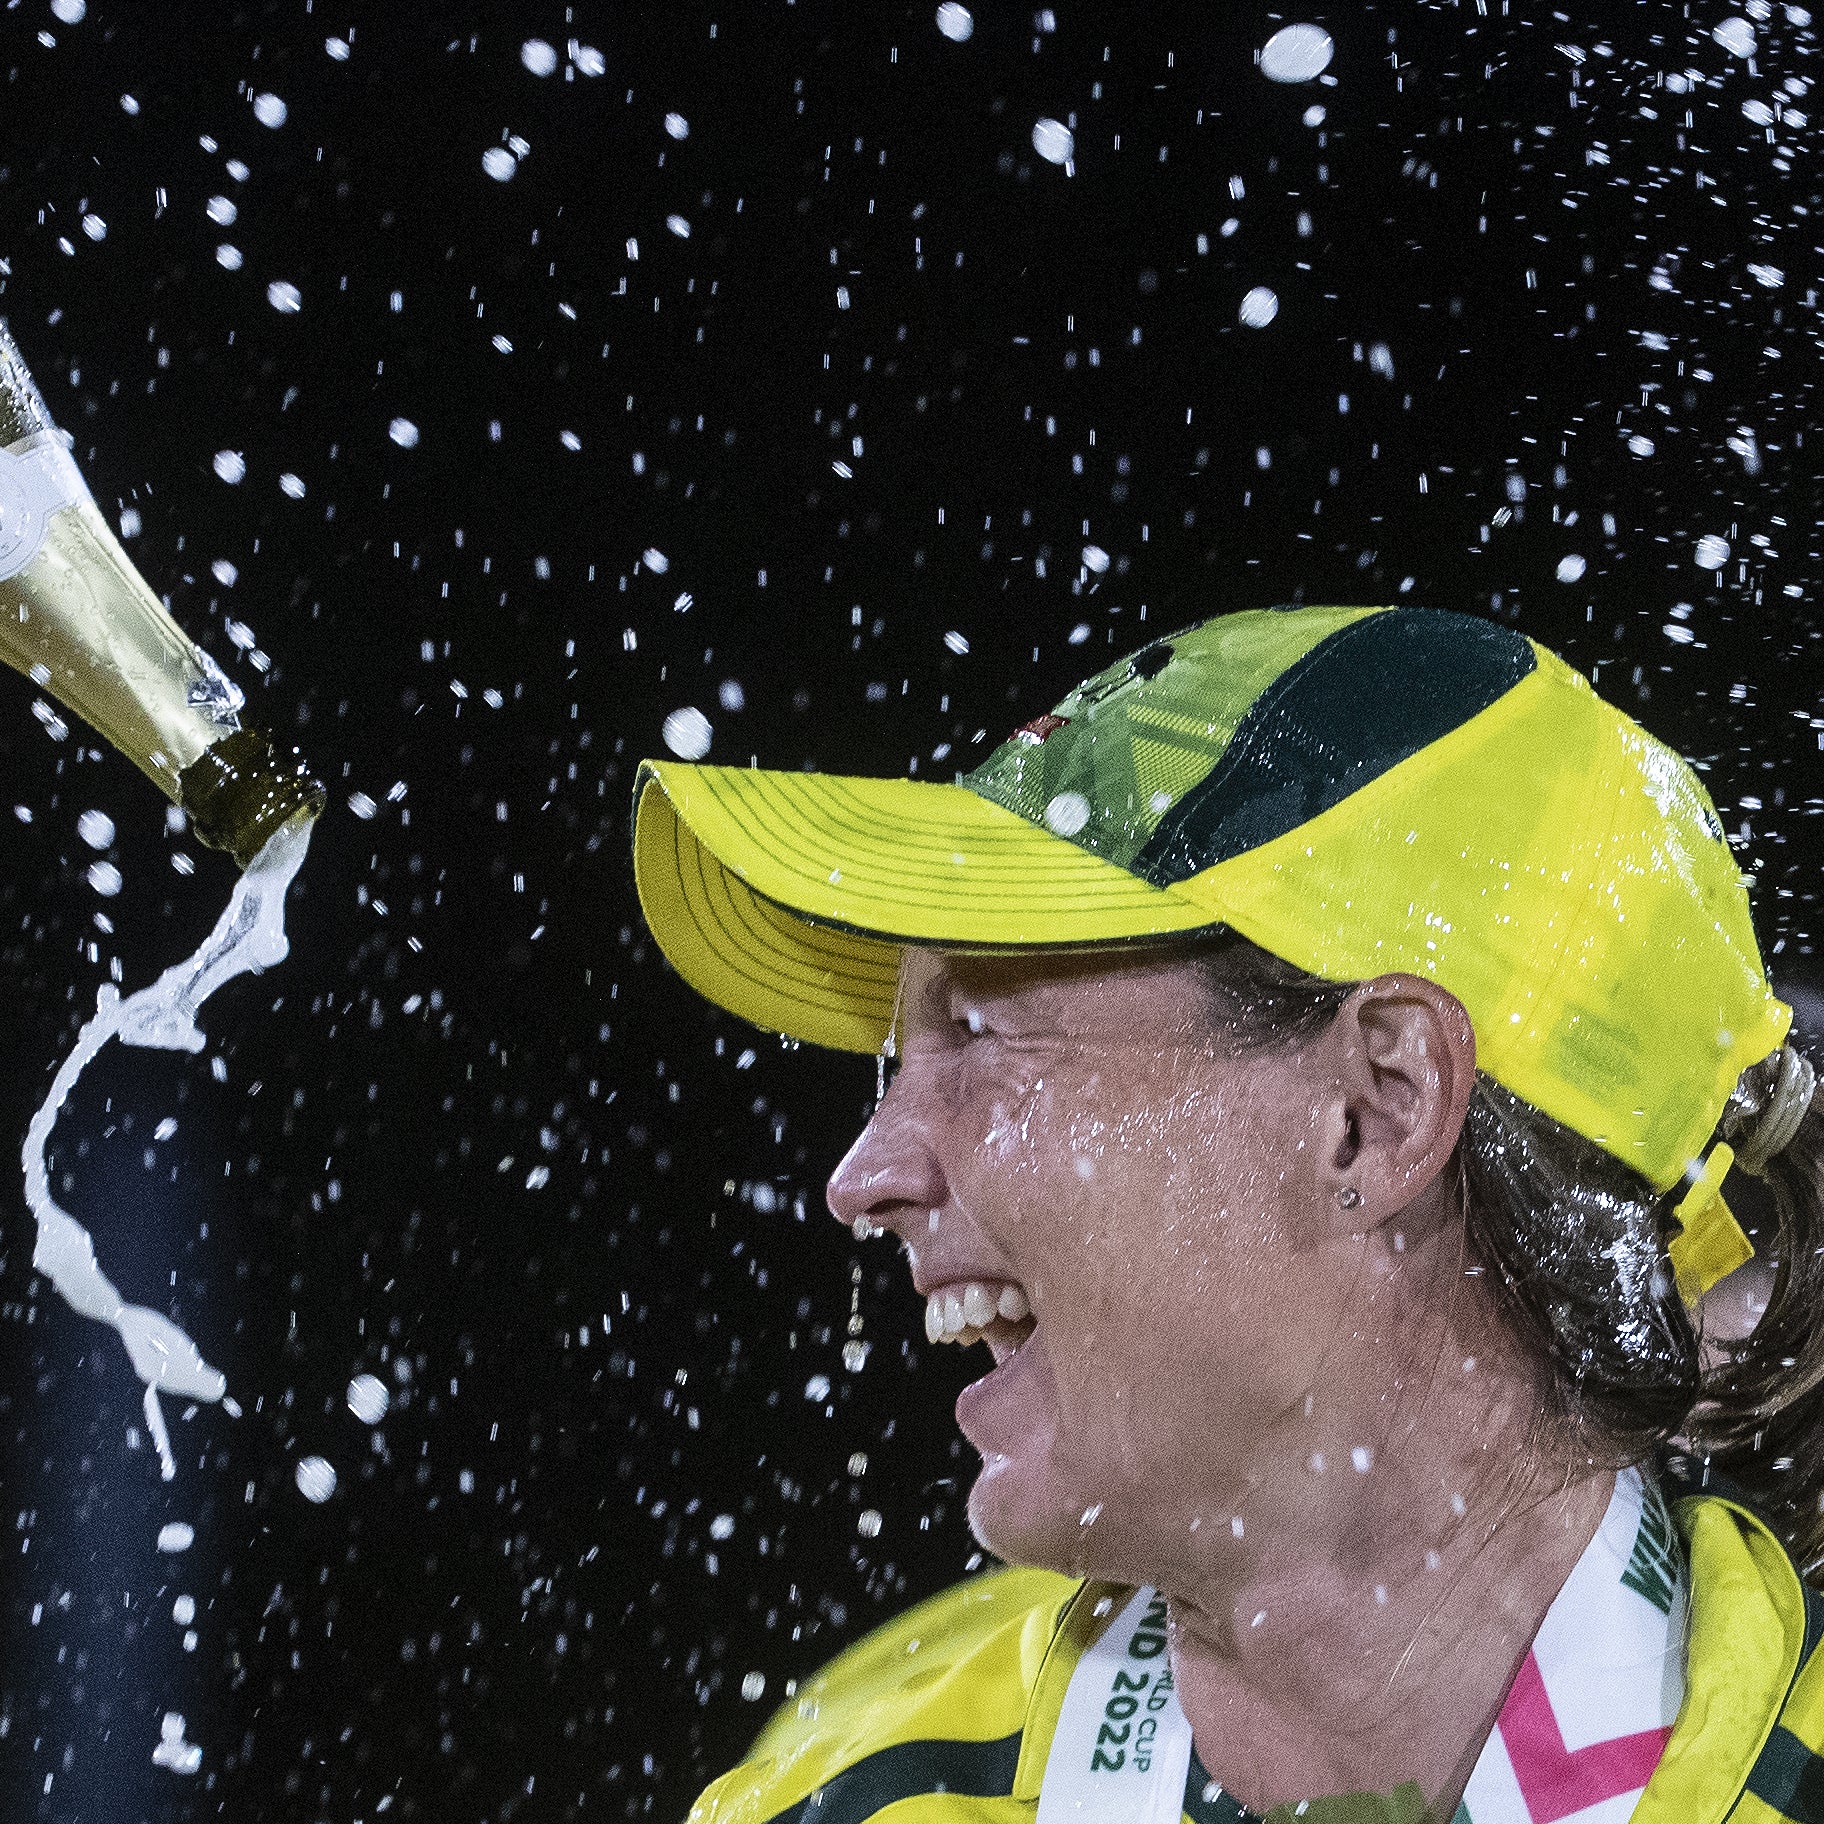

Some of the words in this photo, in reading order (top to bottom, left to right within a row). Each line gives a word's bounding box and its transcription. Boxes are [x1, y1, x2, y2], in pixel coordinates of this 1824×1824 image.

[1147, 1668, 1175, 1711] RLD
[1090, 1669, 1150, 1774] 2022
[1133, 1717, 1157, 1774] CUP
